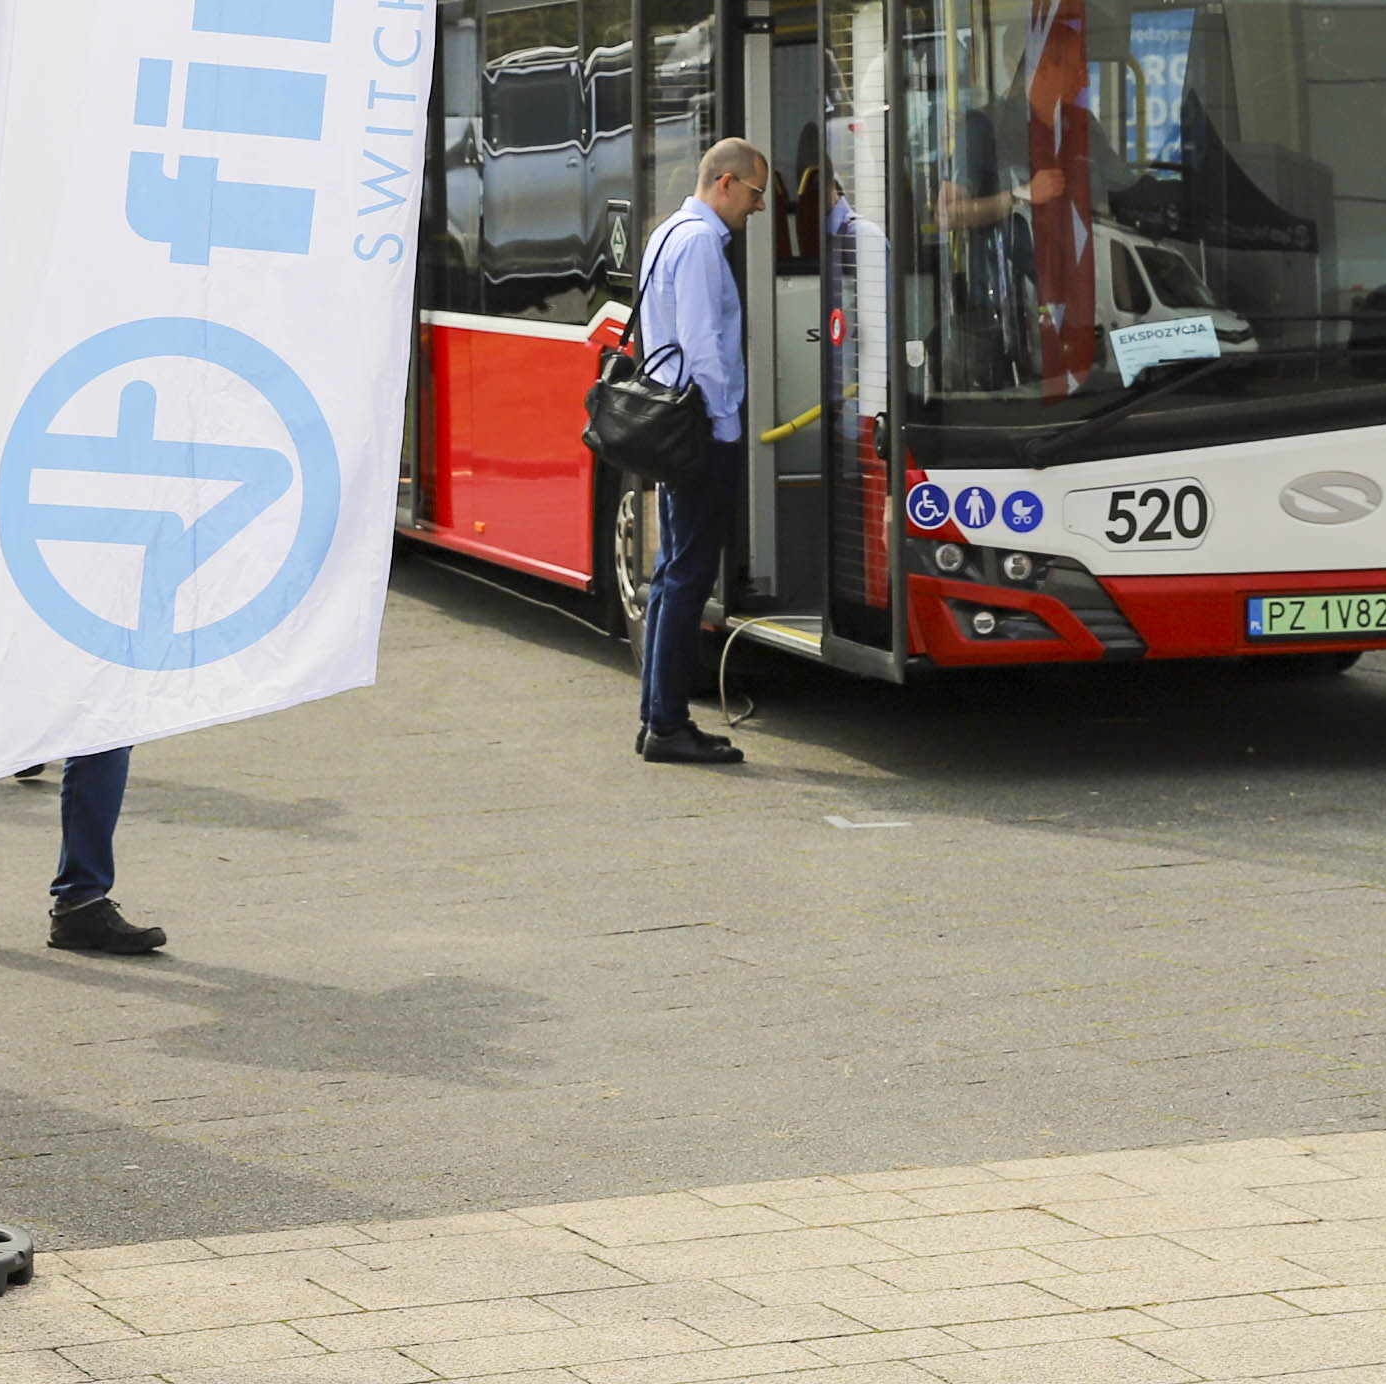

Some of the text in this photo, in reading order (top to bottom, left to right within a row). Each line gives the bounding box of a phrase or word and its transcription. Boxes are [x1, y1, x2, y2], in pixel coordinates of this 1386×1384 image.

[1119, 323, 1208, 345] EKSPOZYCJA
[1105, 485, 1208, 544] 520
[1268, 600, 1307, 632] PZ
